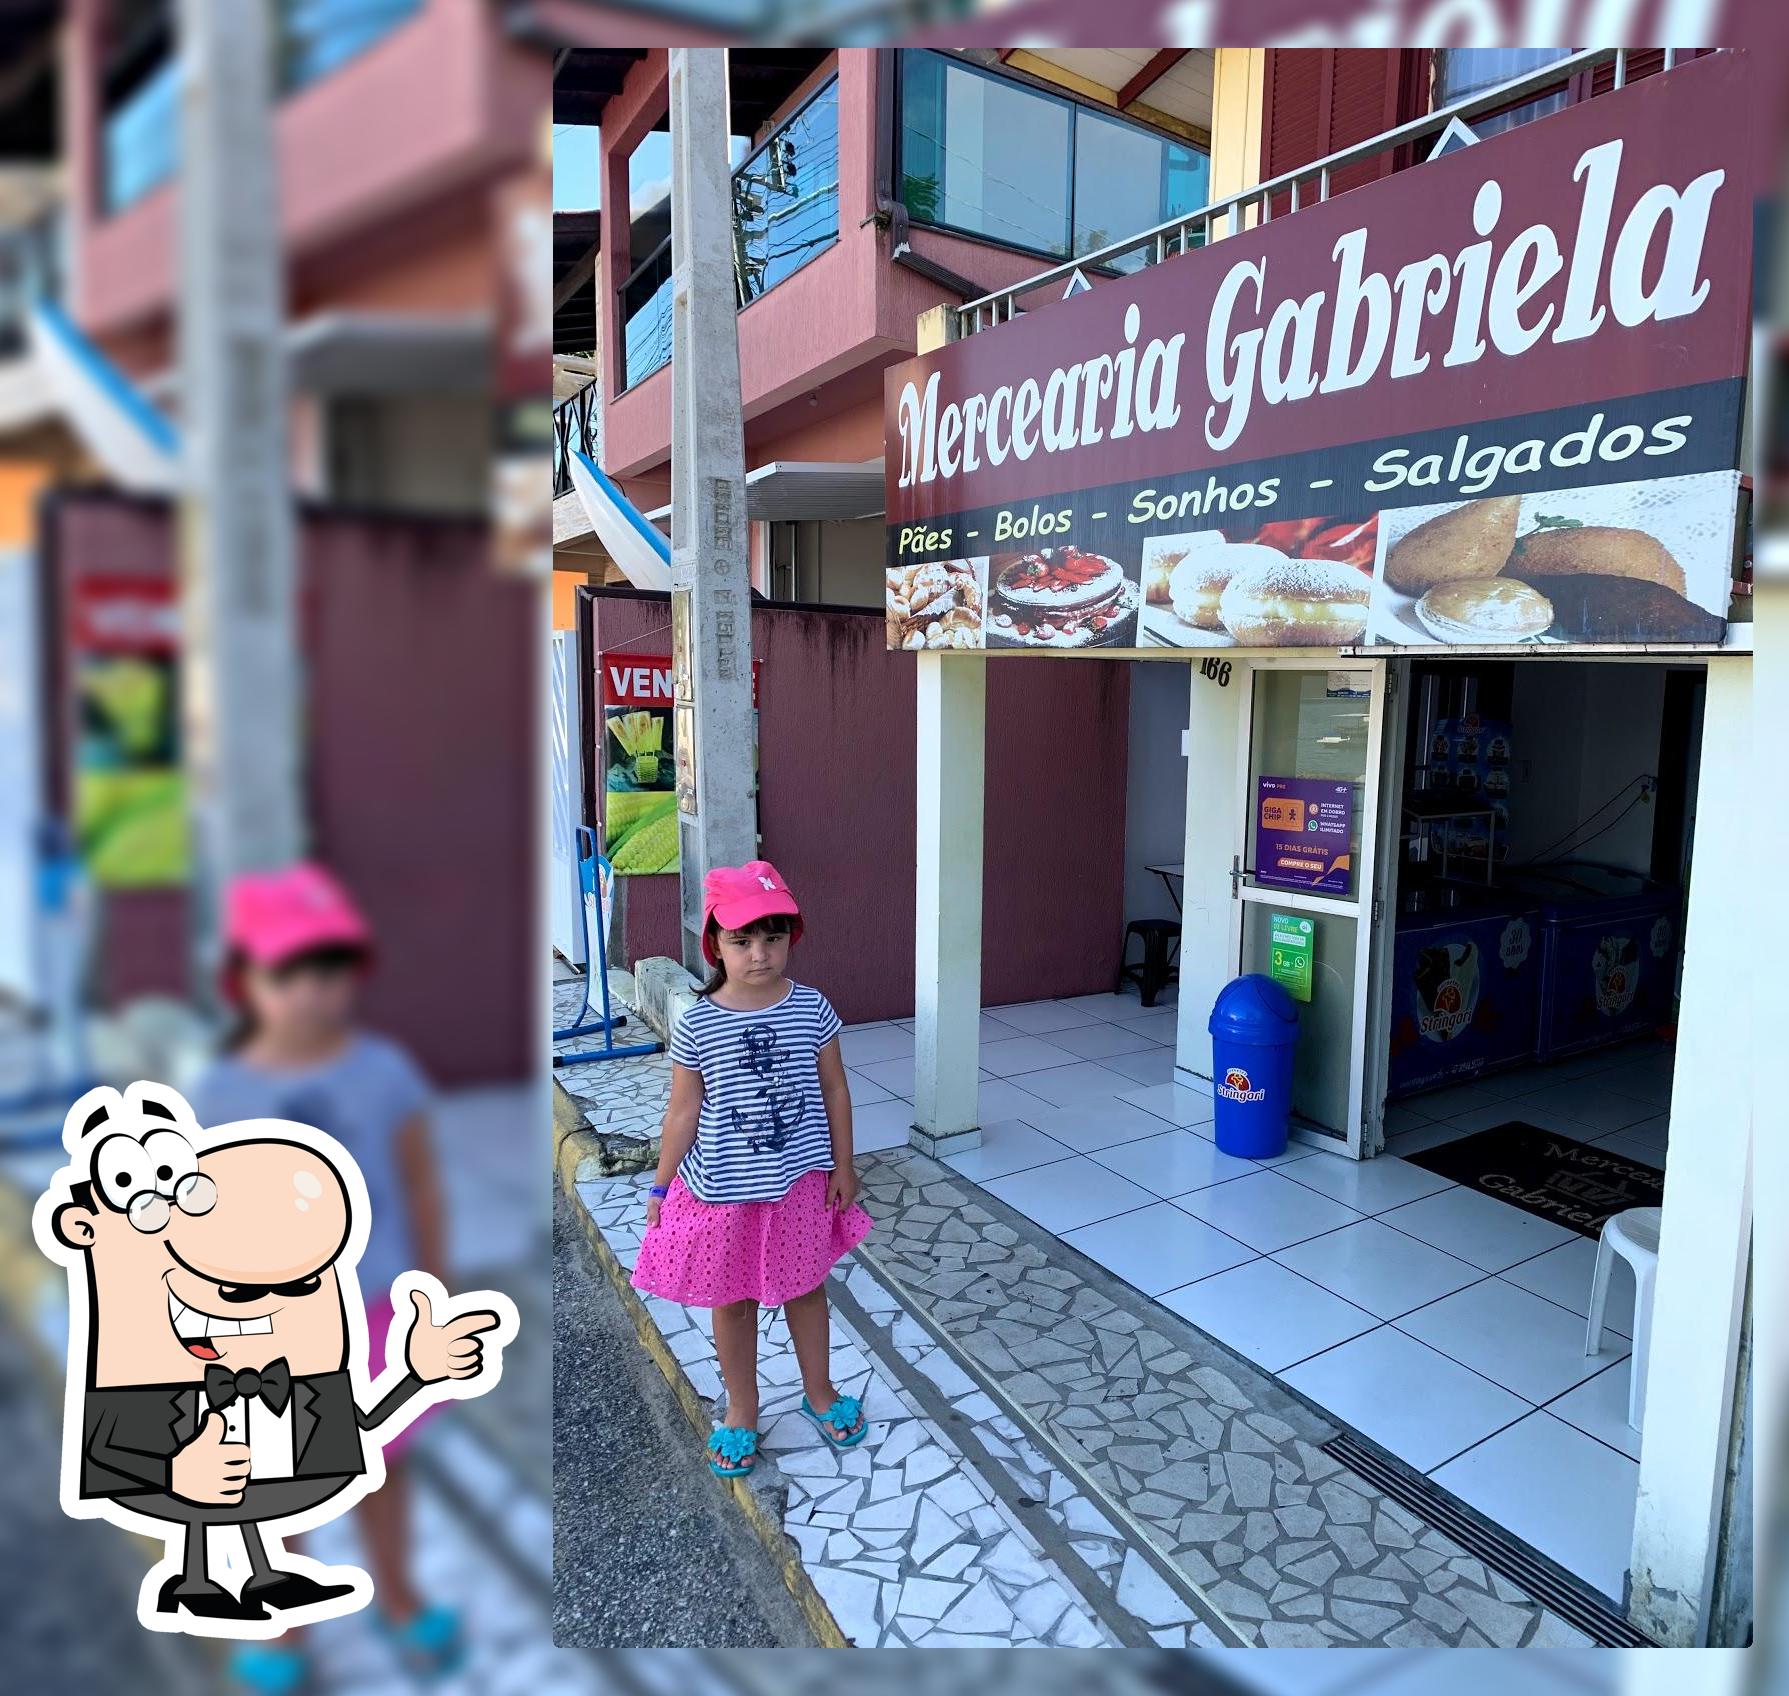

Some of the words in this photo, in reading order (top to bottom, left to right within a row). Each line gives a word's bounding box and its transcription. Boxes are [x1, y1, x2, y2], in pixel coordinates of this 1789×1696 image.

[898, 303, 1186, 489] Mercearia
[1205, 138, 1726, 452] Gabriela
[899, 525, 953, 555] Pães
[995, 505, 1072, 541] Bolos
[1127, 476, 1280, 524] Sonhos
[1364, 413, 1694, 494] Salgados
[610, 666, 672, 698] VEN
[1200, 657, 1232, 687] 166
[1262, 781, 1276, 789] vivo
[1264, 806, 1282, 814] GIGA
[1264, 813, 1282, 821] CHIP
[1284, 844, 1301, 852] DIAS
[1280, 859, 1304, 868] COMPRE
[1310, 862, 1322, 870] SEU
[1274, 951, 1283, 966] 3
[1420, 1009, 1473, 1034] Stringari
[1217, 1084, 1265, 1104] Stringari
[1543, 1142, 1665, 1191] Mercea
[1478, 1173, 1603, 1232] Gabriel
